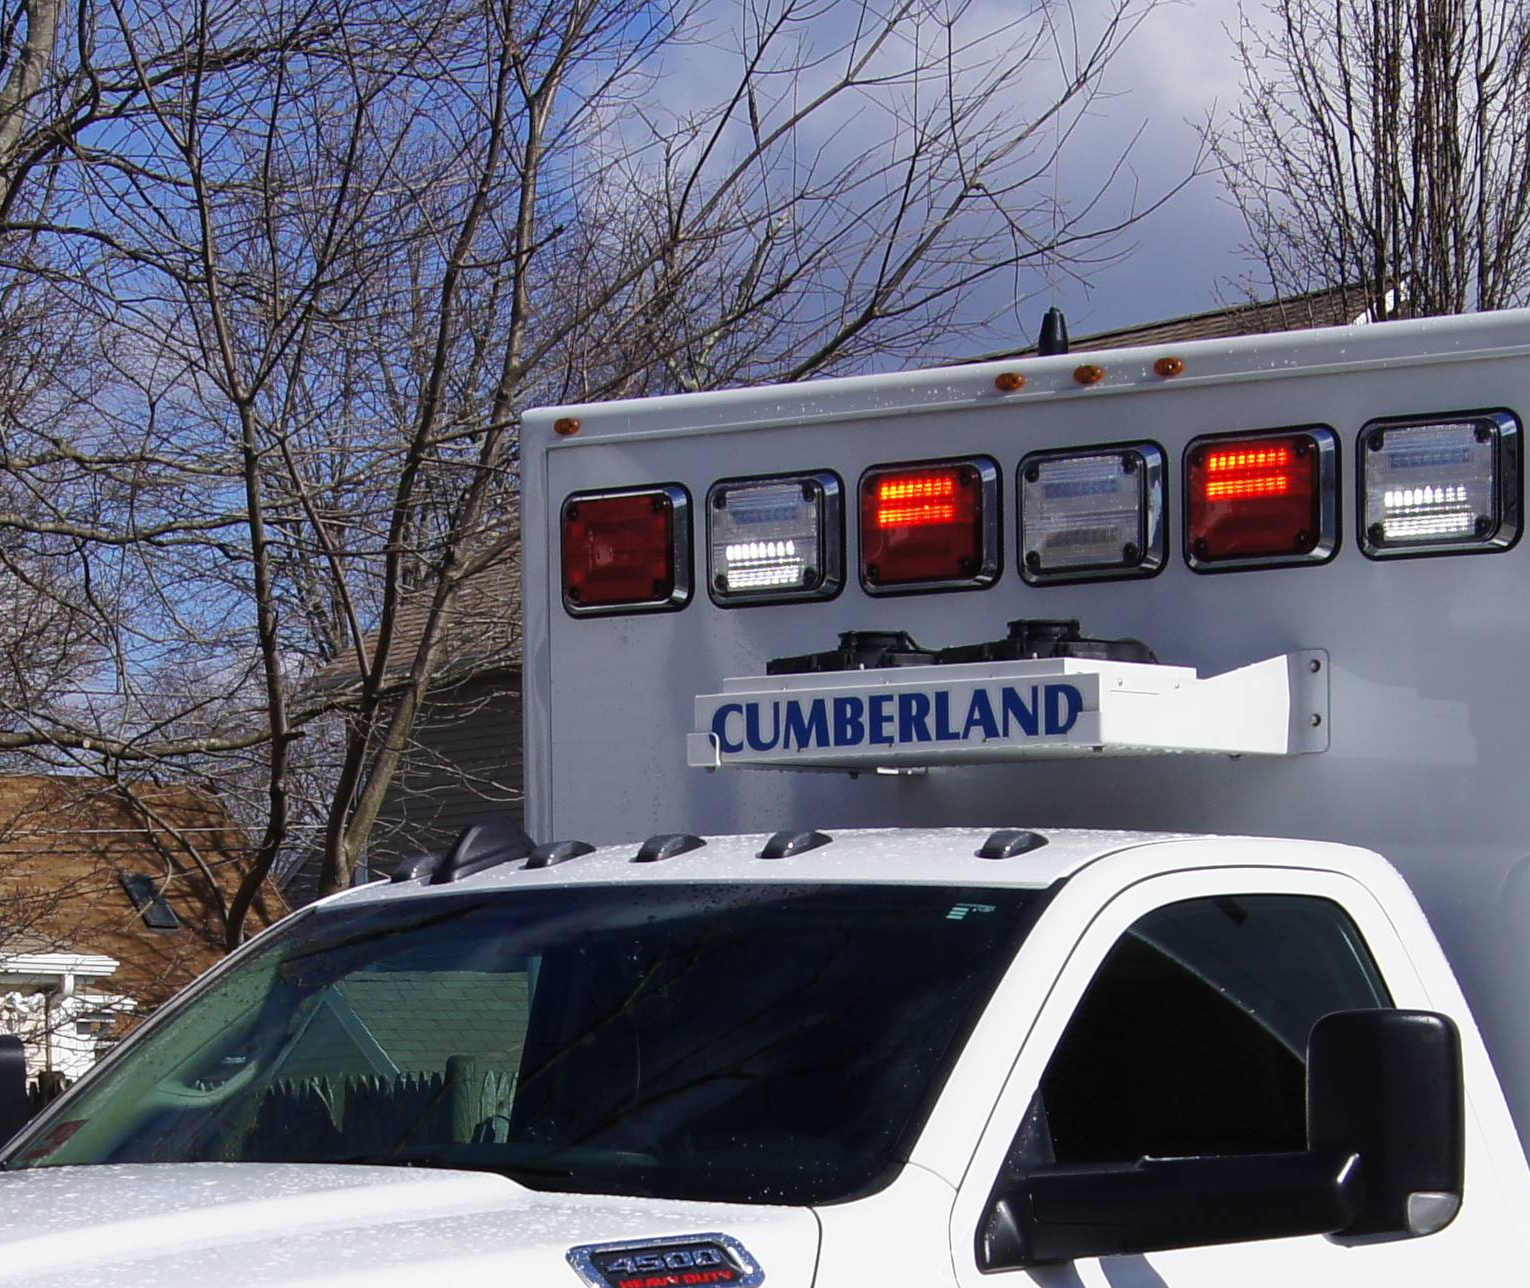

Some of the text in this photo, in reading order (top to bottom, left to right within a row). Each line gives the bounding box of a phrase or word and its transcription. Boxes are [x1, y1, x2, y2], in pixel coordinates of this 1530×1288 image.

[710, 682, 1084, 753] CUMBERLAND
[603, 1248, 723, 1276] 4500
[683, 1269, 734, 1285] DUTY
